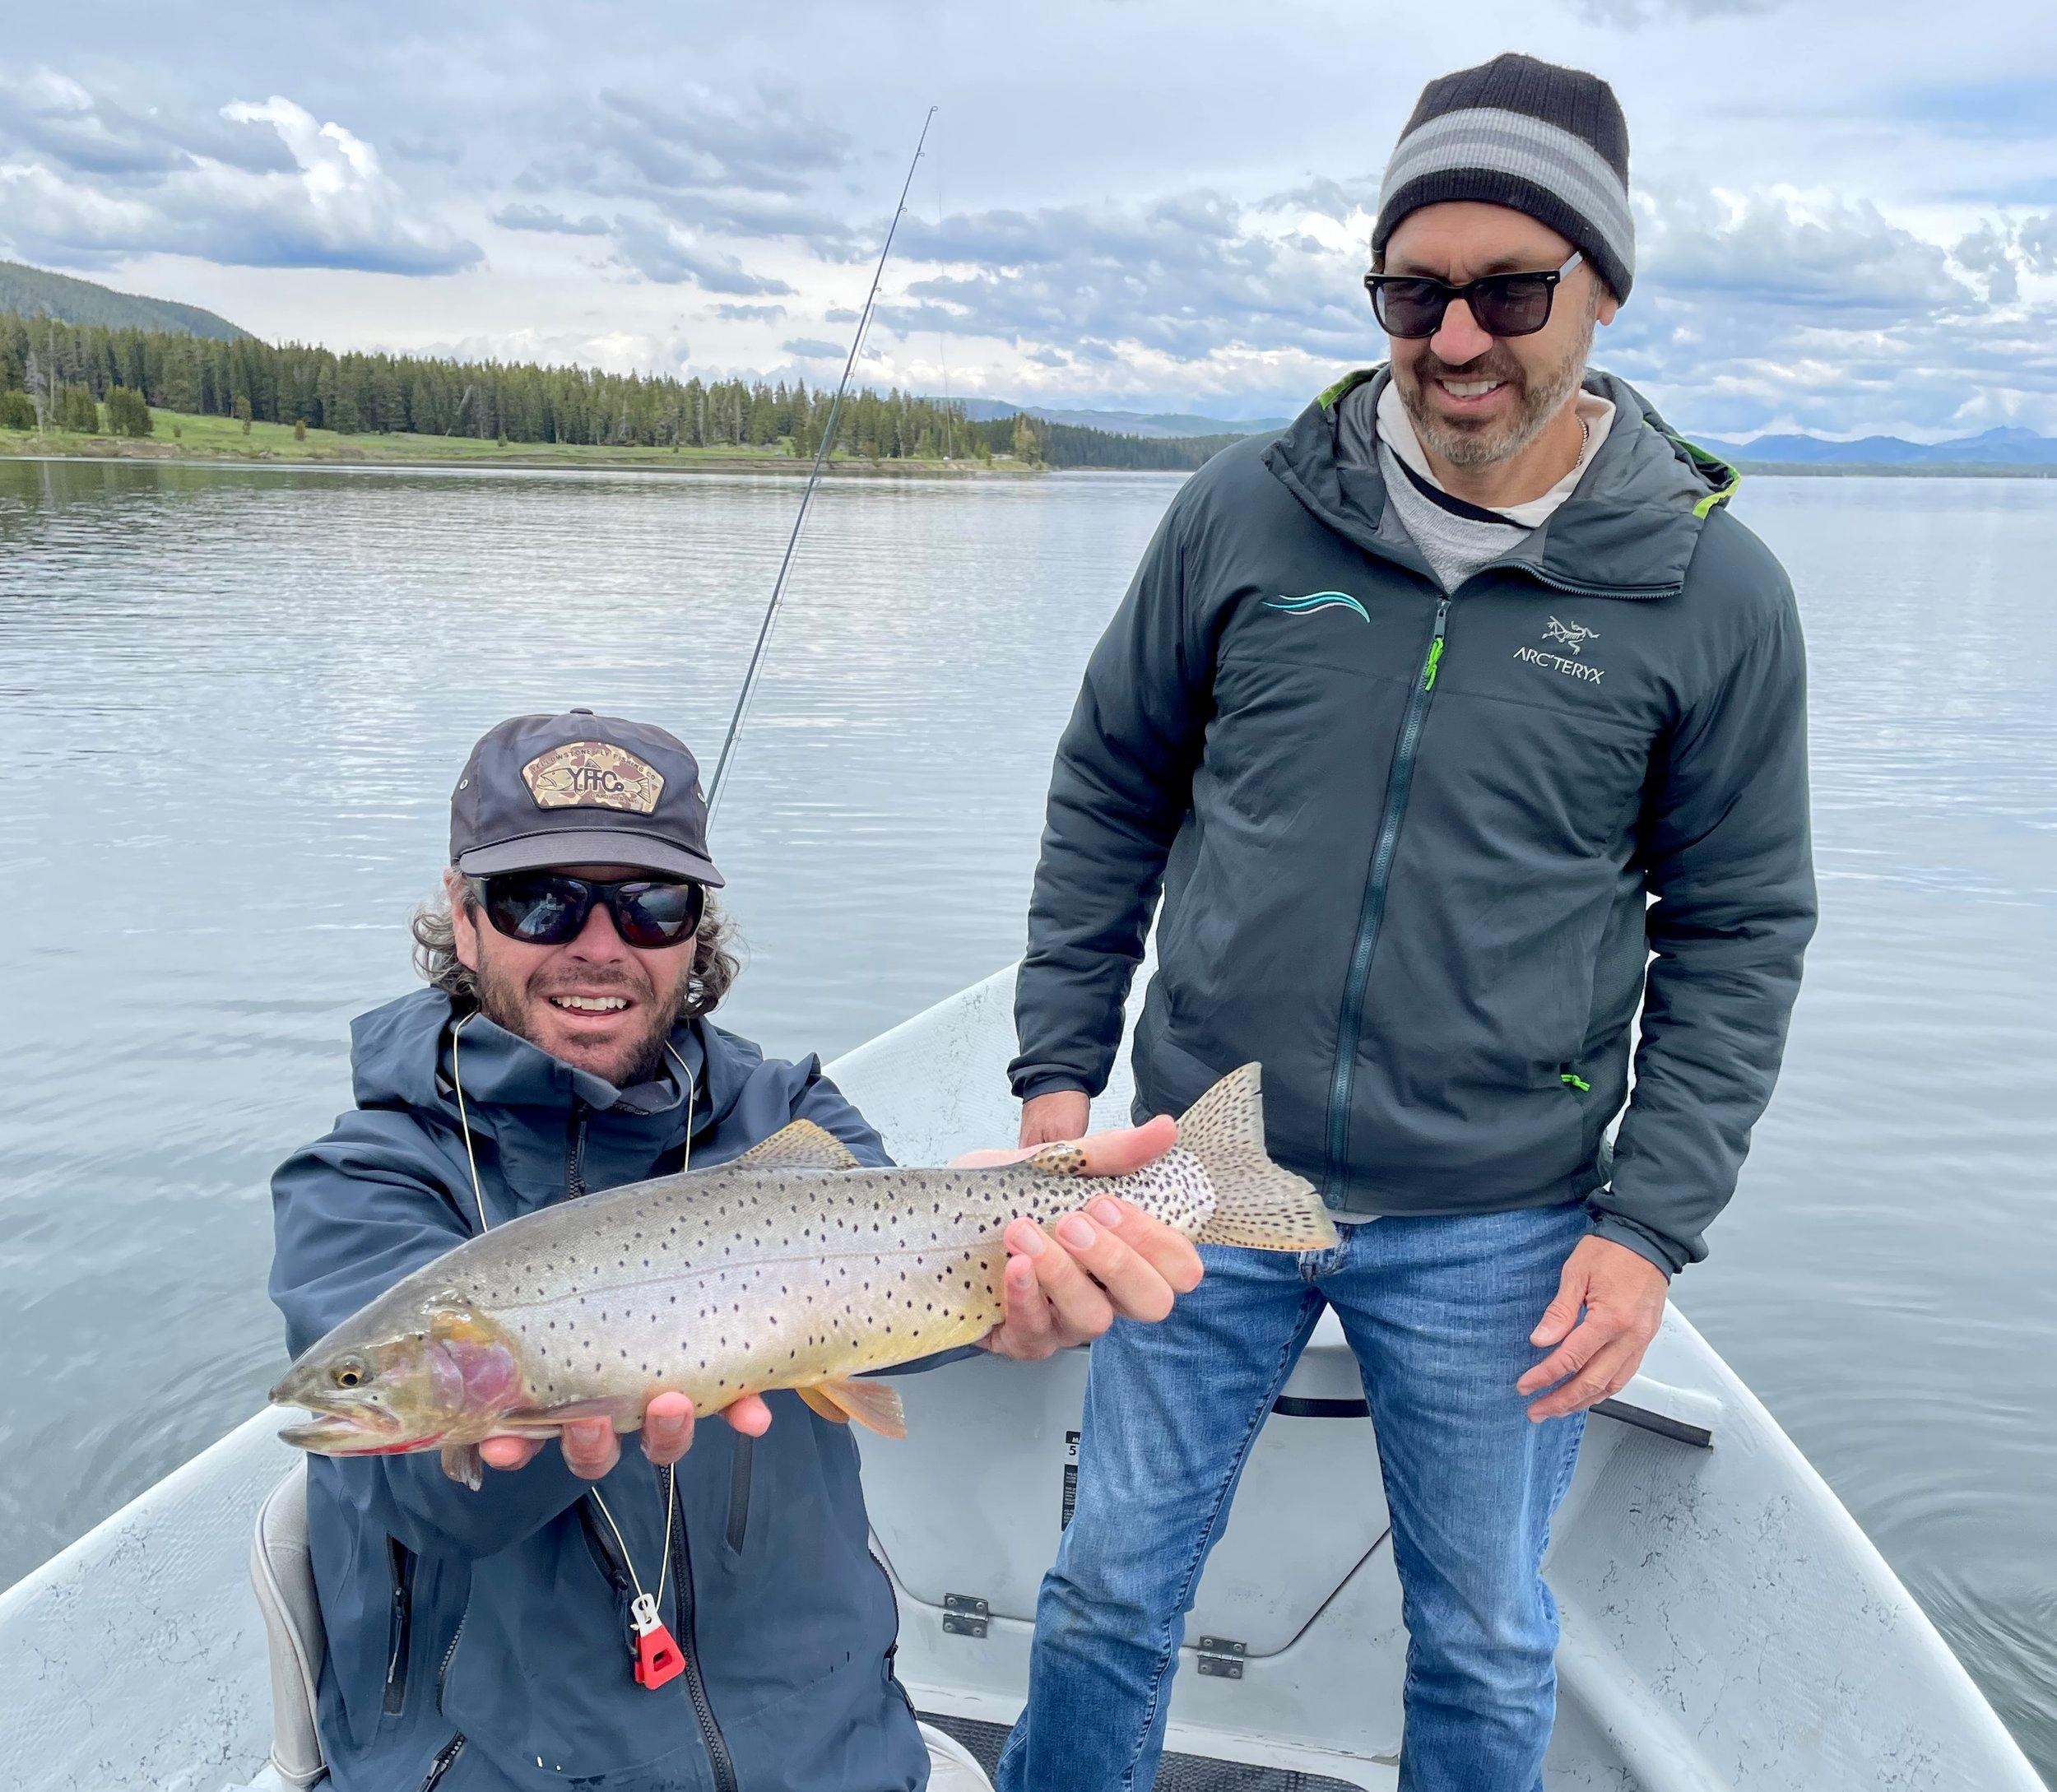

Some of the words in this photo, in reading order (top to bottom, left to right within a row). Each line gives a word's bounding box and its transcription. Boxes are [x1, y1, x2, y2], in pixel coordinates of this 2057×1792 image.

[1513, 646, 1604, 685] ARC'TERYX
[529, 748, 592, 772] YELLOWSTONE
[596, 749, 610, 757] FLY
[613, 754, 644, 773] FISHING
[1069, 1446, 1076, 1455] 5
